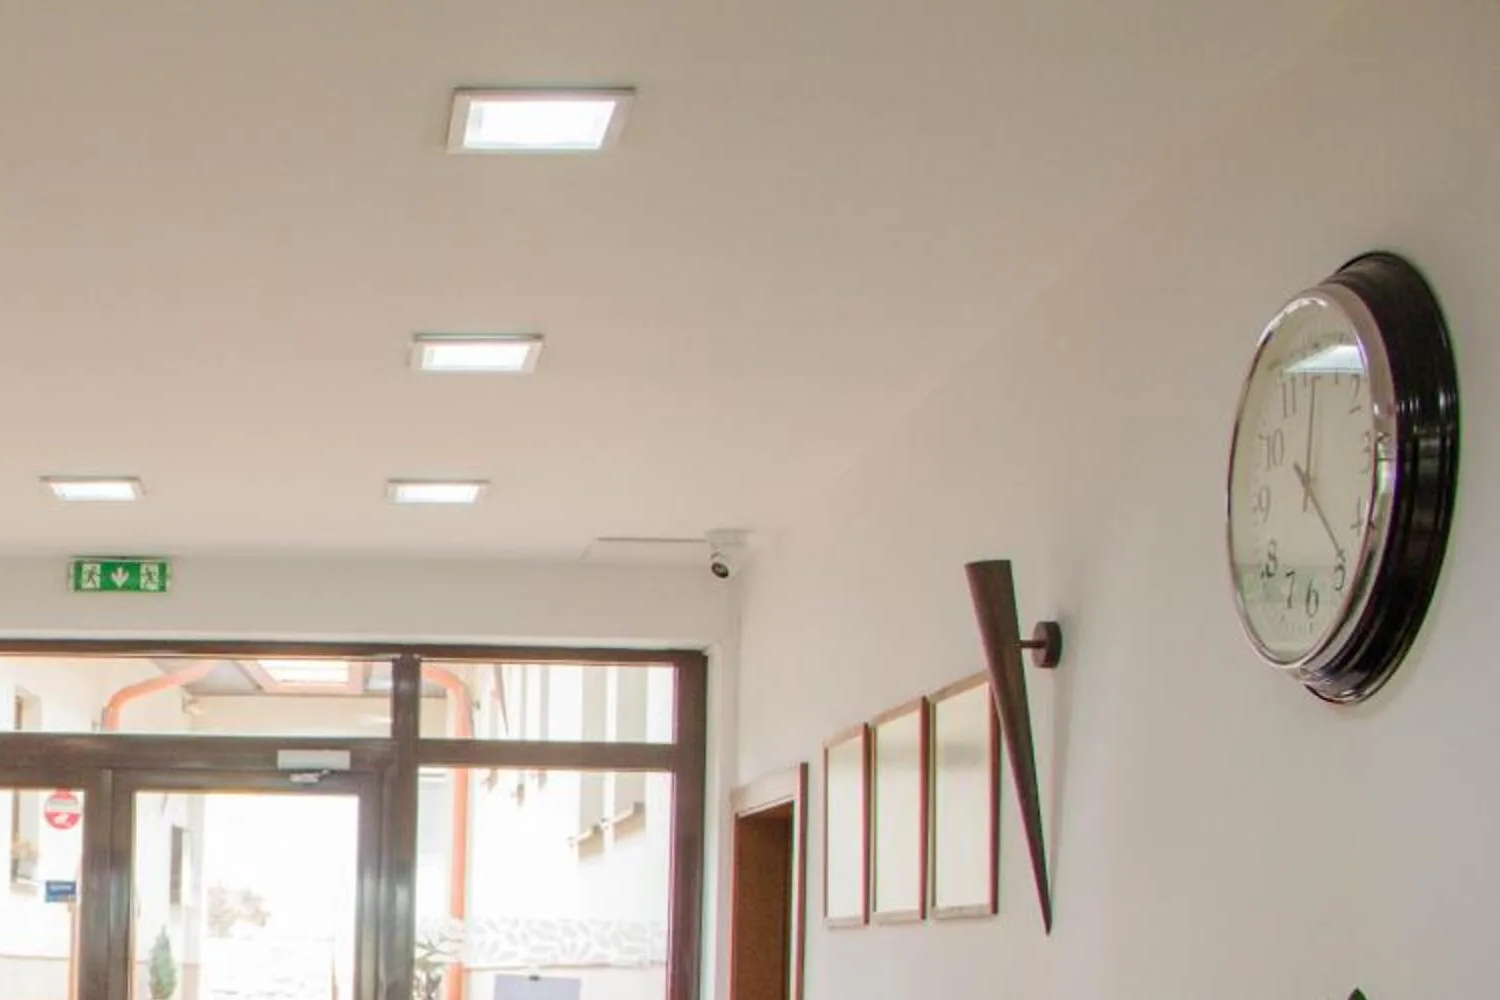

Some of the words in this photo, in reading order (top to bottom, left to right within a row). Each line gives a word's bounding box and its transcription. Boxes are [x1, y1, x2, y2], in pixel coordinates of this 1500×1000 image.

[1258, 428, 1285, 470] 10
[1285, 570, 1296, 609] 7
[1306, 578, 1319, 618] 6
